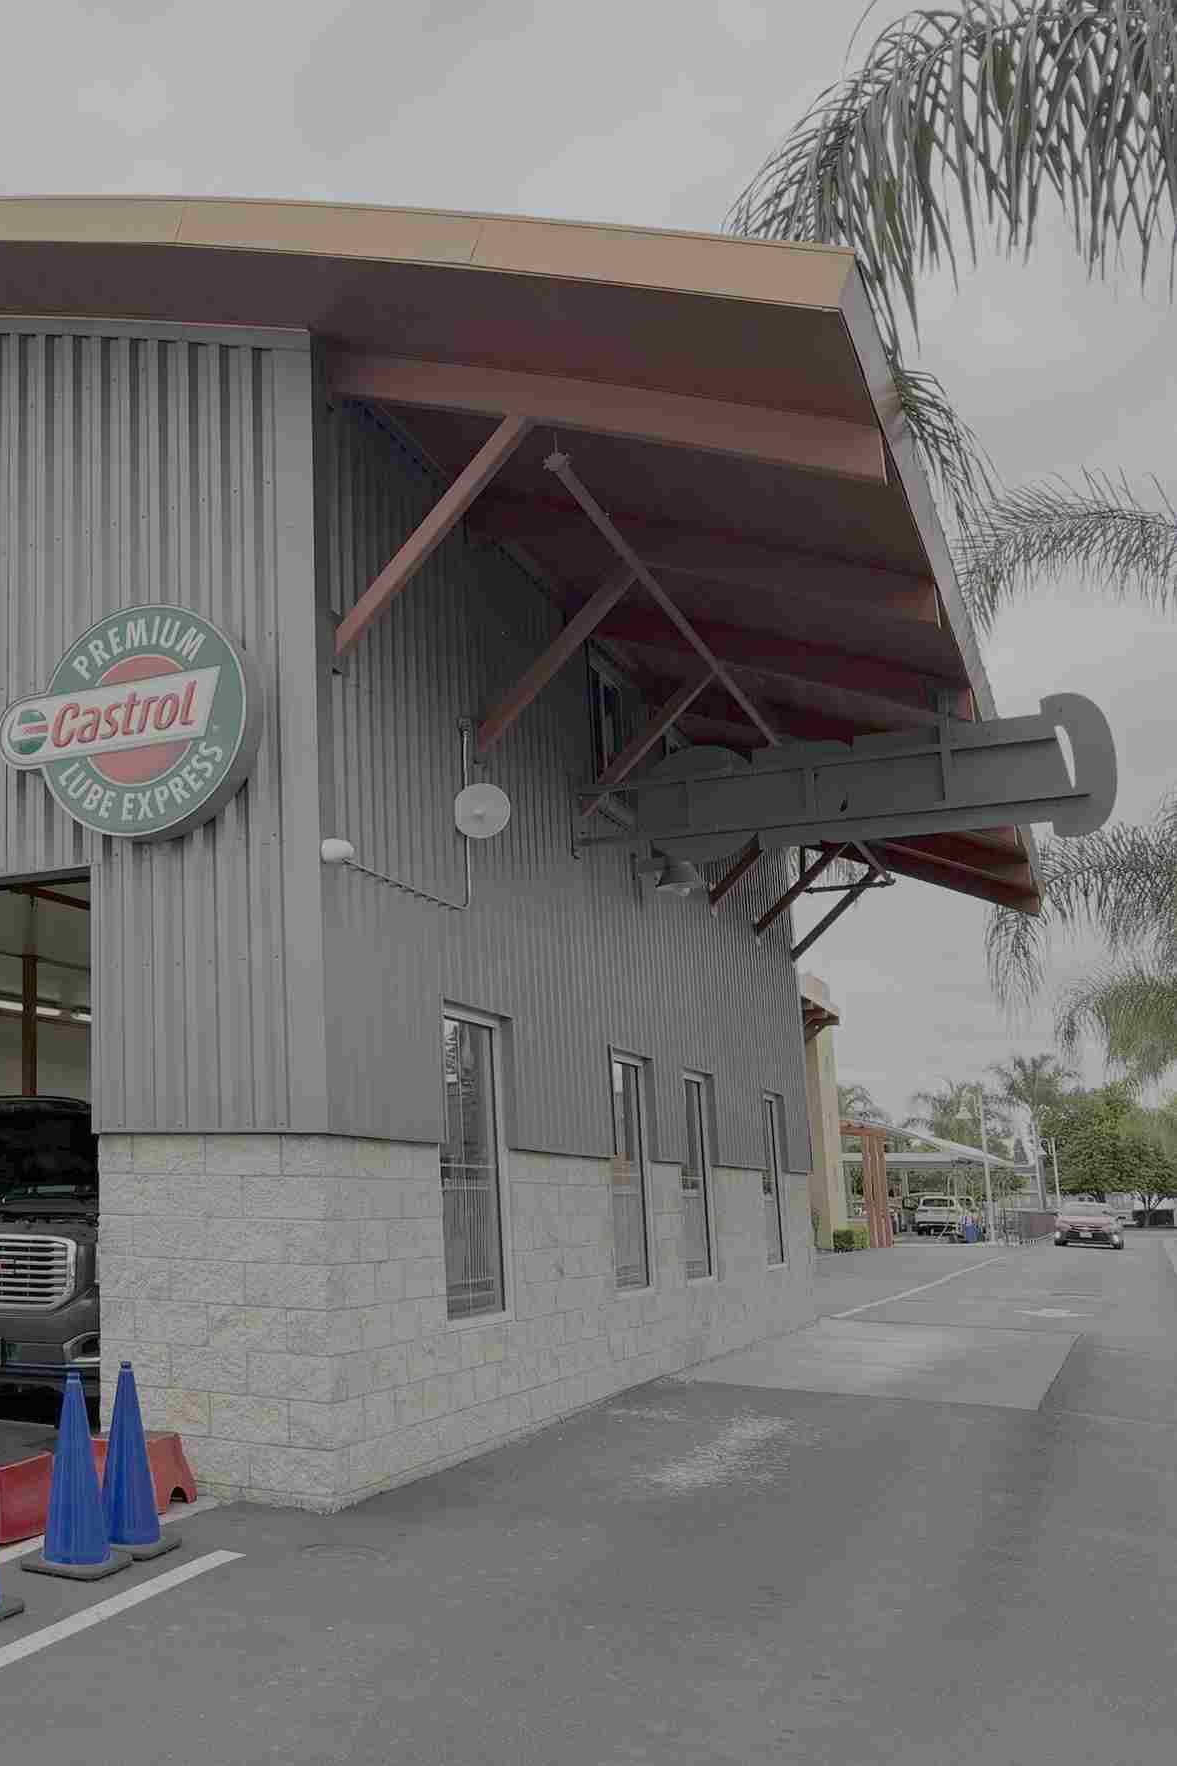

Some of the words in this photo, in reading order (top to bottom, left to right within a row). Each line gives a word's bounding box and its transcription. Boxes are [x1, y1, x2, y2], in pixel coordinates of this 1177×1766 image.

[72, 615, 206, 680] PREMIUM
[52, 680, 198, 748] Castrol
[58, 762, 116, 818] LUBE
[121, 741, 223, 821] EXPRESS
